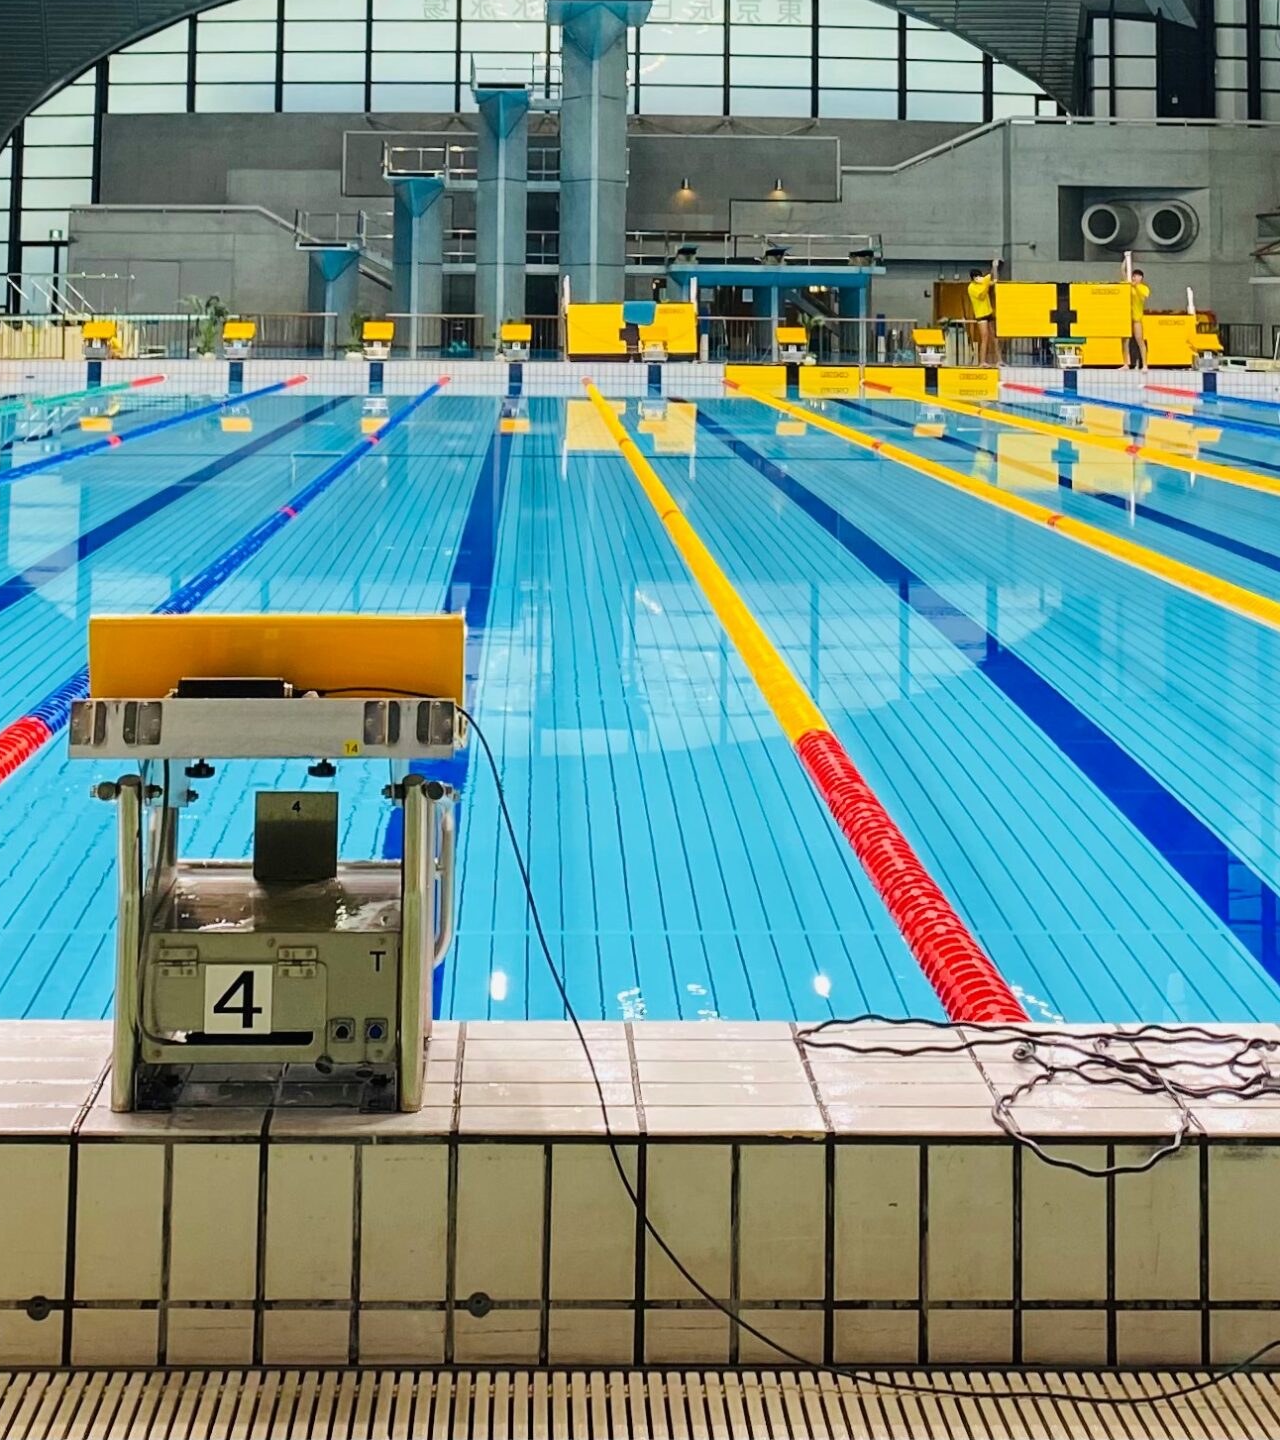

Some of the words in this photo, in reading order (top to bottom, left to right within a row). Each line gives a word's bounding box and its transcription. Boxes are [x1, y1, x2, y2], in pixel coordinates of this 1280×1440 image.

[291, 801, 301, 813] 4
[369, 951, 386, 972] T
[213, 970, 263, 1029] 4
